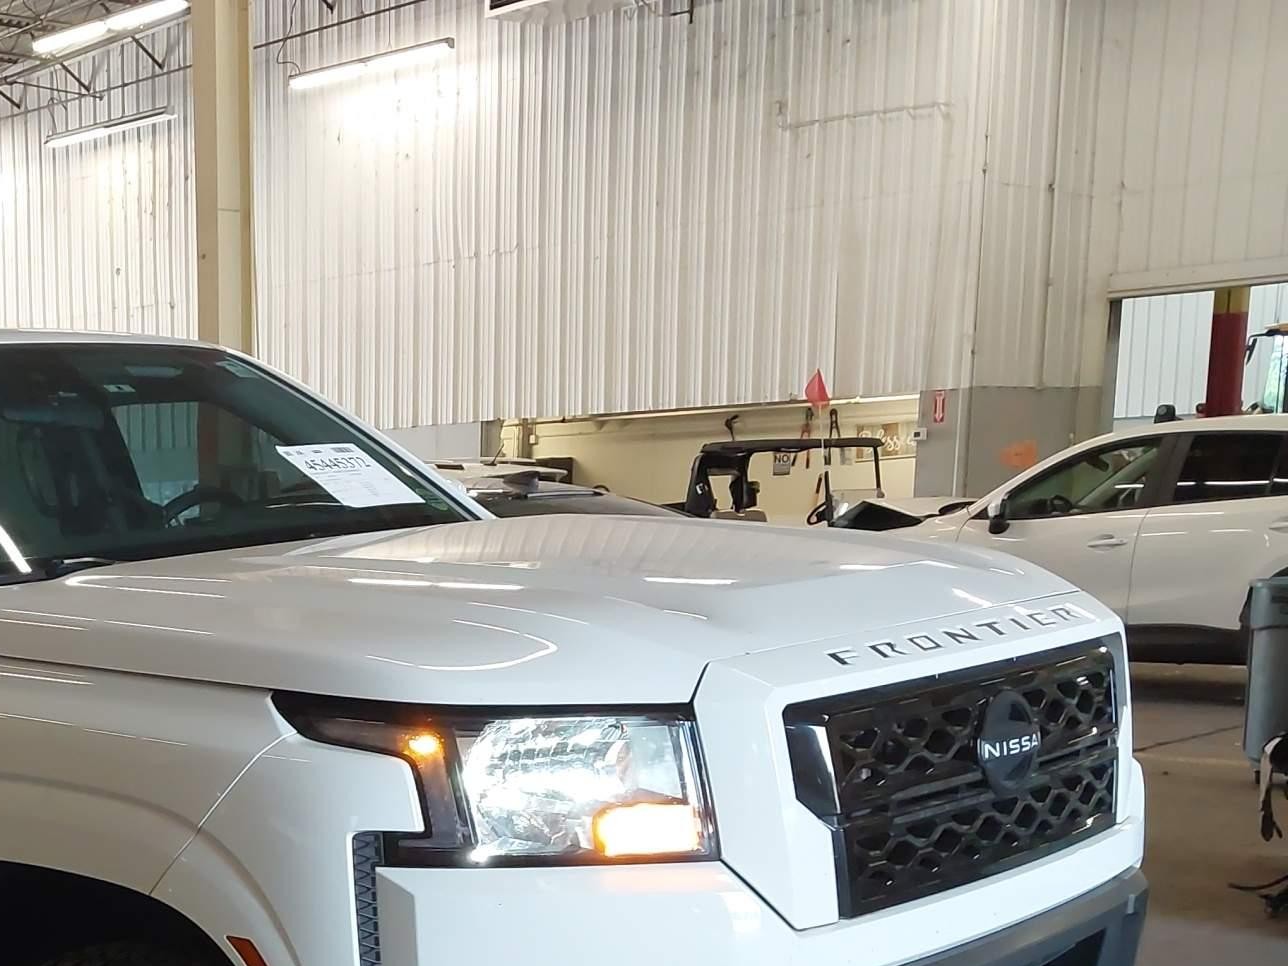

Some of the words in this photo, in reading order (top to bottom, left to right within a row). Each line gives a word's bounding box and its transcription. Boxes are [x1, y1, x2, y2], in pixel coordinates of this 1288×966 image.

[304, 456, 372, 471] 45445372
[774, 453, 790, 464] NO
[826, 607, 1082, 666] FRONTIER
[983, 731, 1041, 759] NISSA
